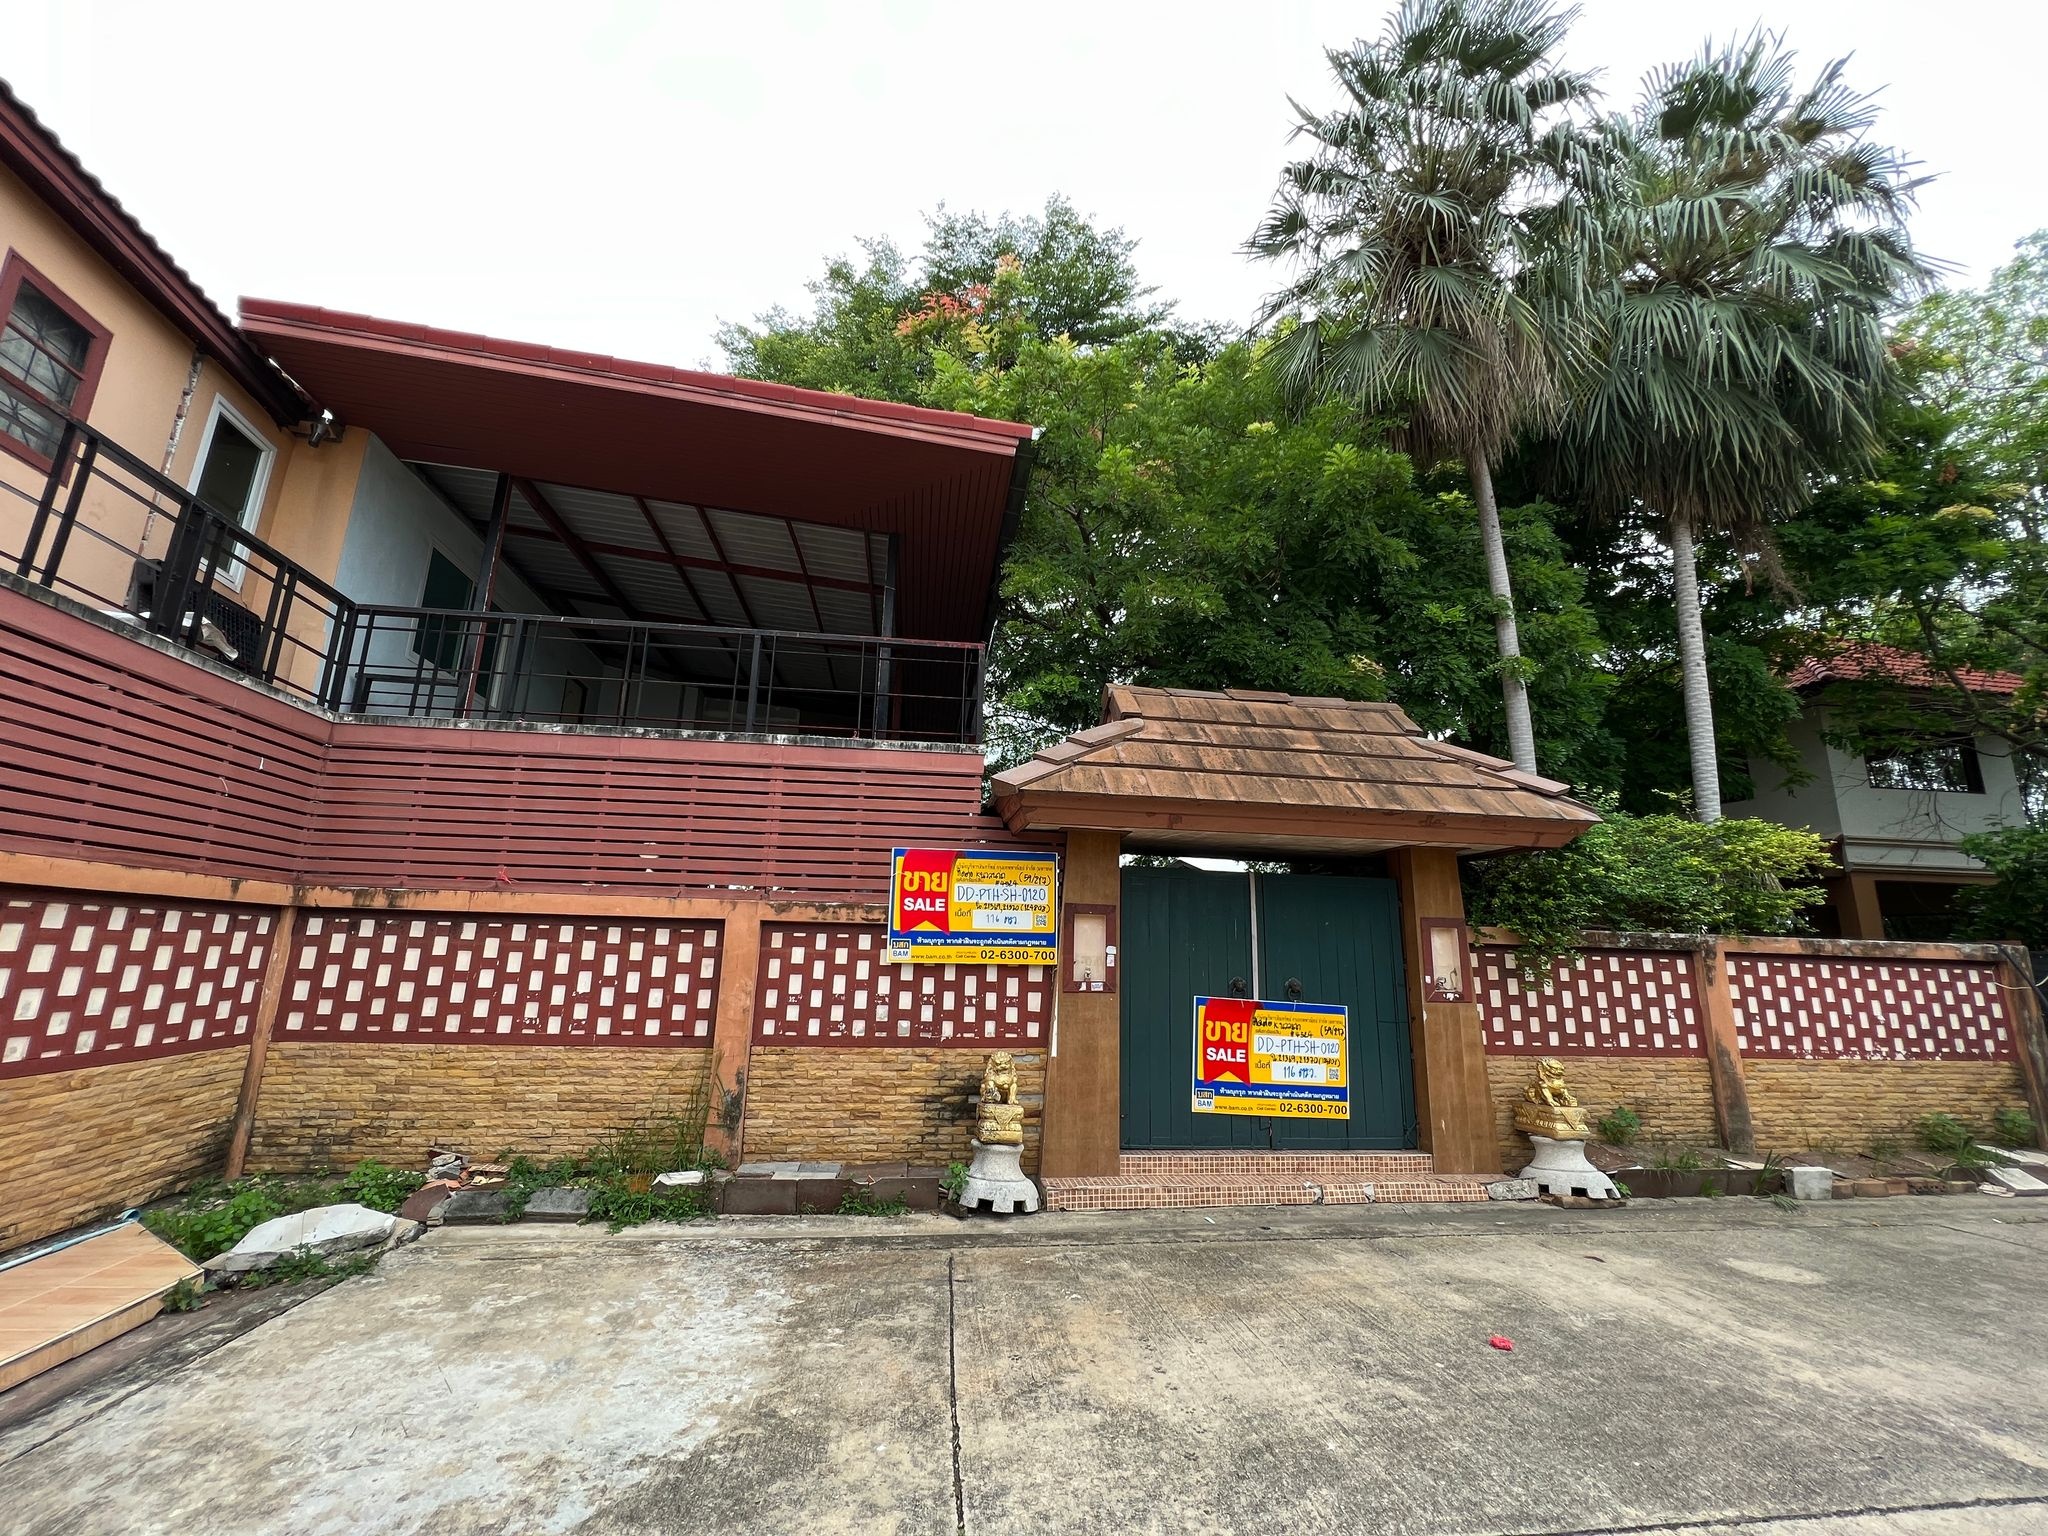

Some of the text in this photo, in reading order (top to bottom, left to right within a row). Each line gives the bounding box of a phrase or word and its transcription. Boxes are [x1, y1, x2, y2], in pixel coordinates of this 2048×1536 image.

[903, 870, 947, 892] ขาย
[957, 885, 1046, 902] DD-PTH-SH-0120
[903, 897, 946, 911] SALE
[892, 950, 909, 958] BAM
[980, 950, 1055, 960] 02-6300-700
[1205, 1020, 1248, 1043] ขาย
[1257, 1036, 1340, 1056] DD-PTH-SH-0120
[1206, 1047, 1247, 1063] SALE
[1283, 1065, 1295, 1078] 116
[1197, 1099, 1213, 1107] BAM
[1279, 1102, 1348, 1115] 02-6300-700
